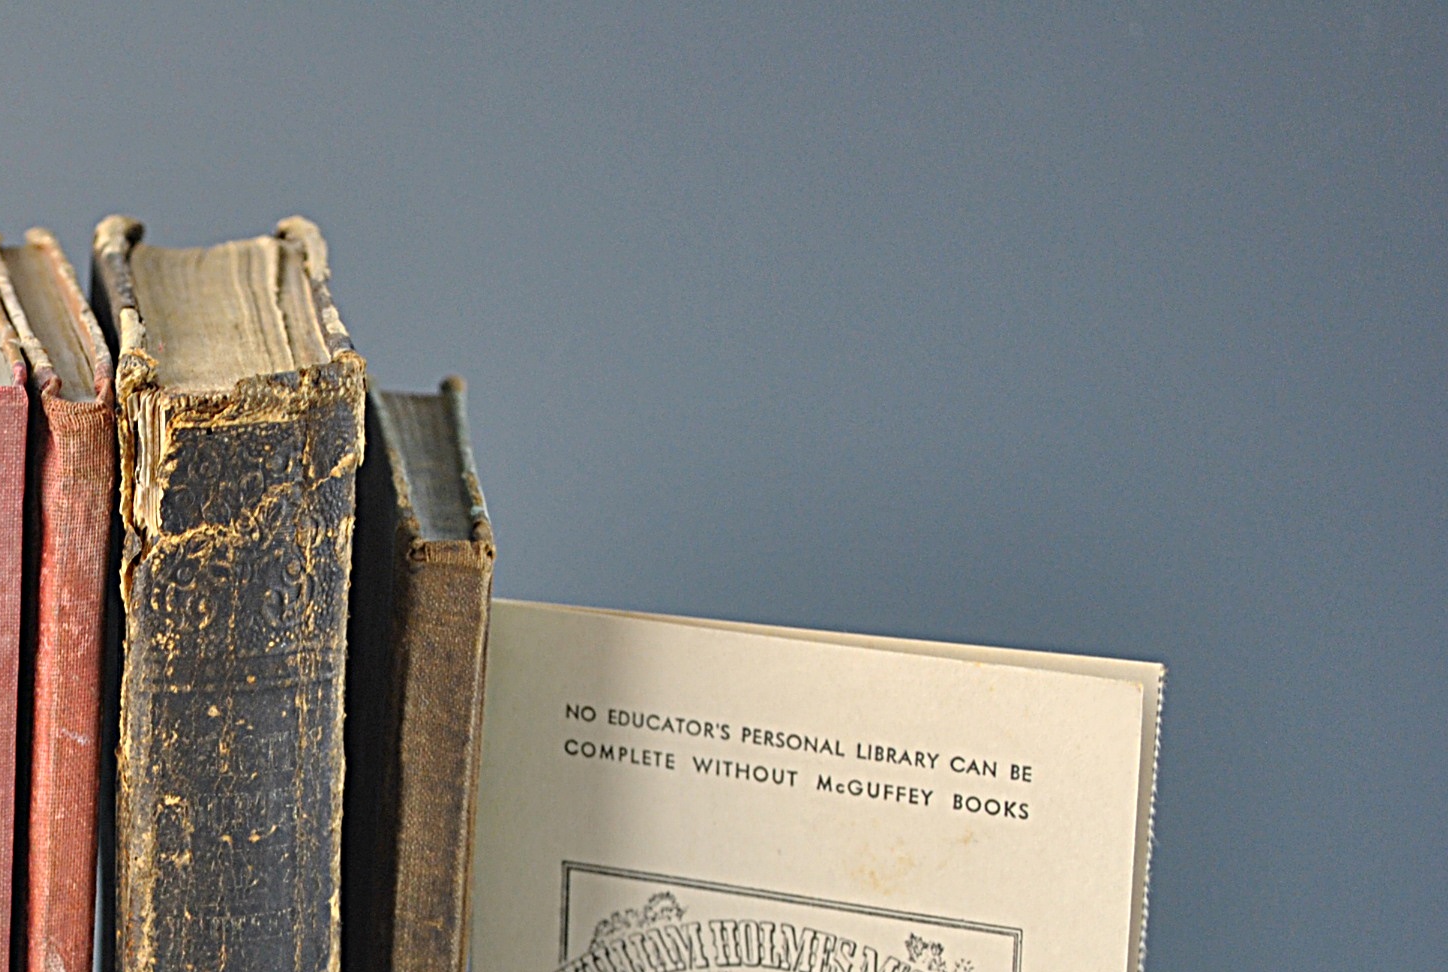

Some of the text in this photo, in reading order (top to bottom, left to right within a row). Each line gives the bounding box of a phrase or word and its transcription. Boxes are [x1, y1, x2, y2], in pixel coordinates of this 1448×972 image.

[564, 739, 1028, 820] COMPLETE WITHOUT McGUFFEY BOOKS
[566, 704, 1032, 782] NO EDUCATOR'S PERSONAL LIBRARY CAN BE
